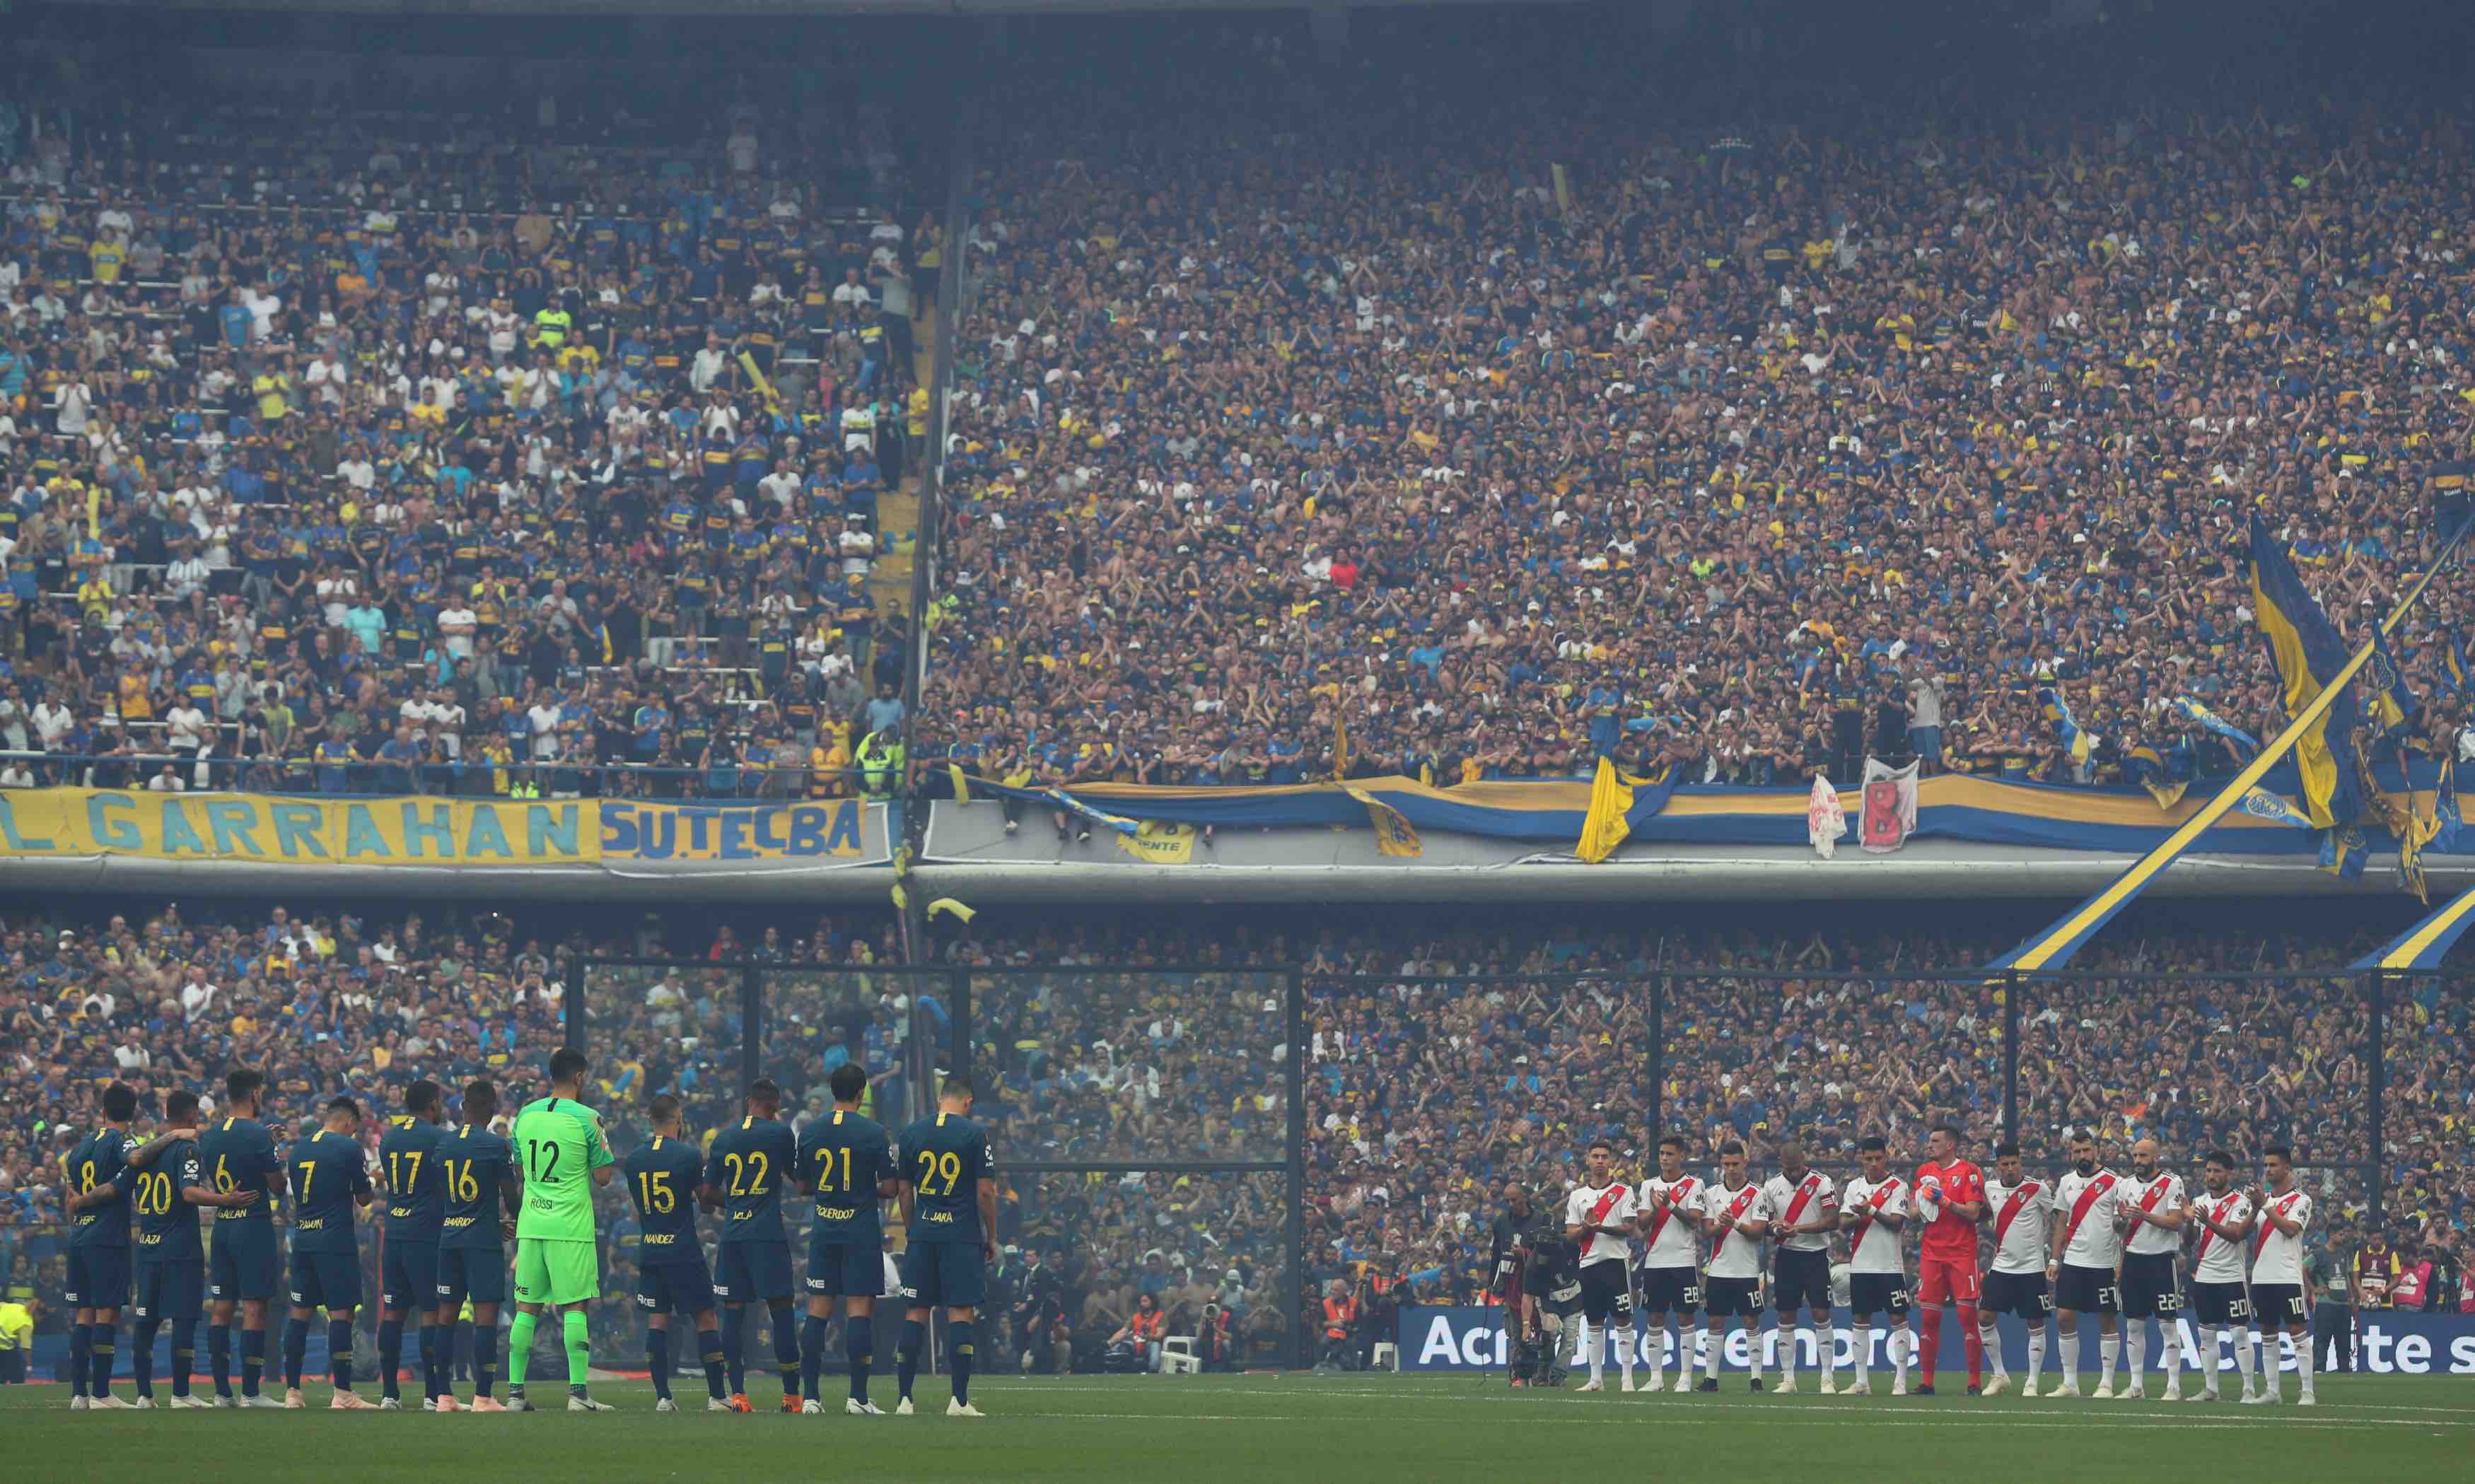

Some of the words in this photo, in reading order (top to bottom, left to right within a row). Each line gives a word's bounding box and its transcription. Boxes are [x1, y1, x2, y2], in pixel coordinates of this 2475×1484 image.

[86, 792, 578, 858] GARRAHAN
[81, 1160, 97, 1195] 8
[215, 1154, 234, 1194] 6
[389, 1151, 424, 1194] 17
[528, 1139, 559, 1183] 12
[724, 1151, 769, 1196] 22
[814, 1147, 851, 1191] 21
[918, 1150, 961, 1196] 29
[136, 1172, 171, 1215] 20
[298, 1160, 315, 1203] 7
[444, 1159, 479, 1203] 16
[639, 1171, 675, 1215] 15
[530, 1198, 553, 1210] ROSSI
[930, 1212, 953, 1222] JARA
[1683, 1286, 1697, 1304] 28
[1747, 1290, 1761, 1309] 19
[1890, 1289, 1909, 1307] 24
[1968, 1275, 1974, 1292] 1
[2097, 1287, 2116, 1305] 27
[2157, 1294, 2175, 1311] 22
[2229, 1299, 2248, 1318] 20
[2288, 1297, 2303, 1315] 10
